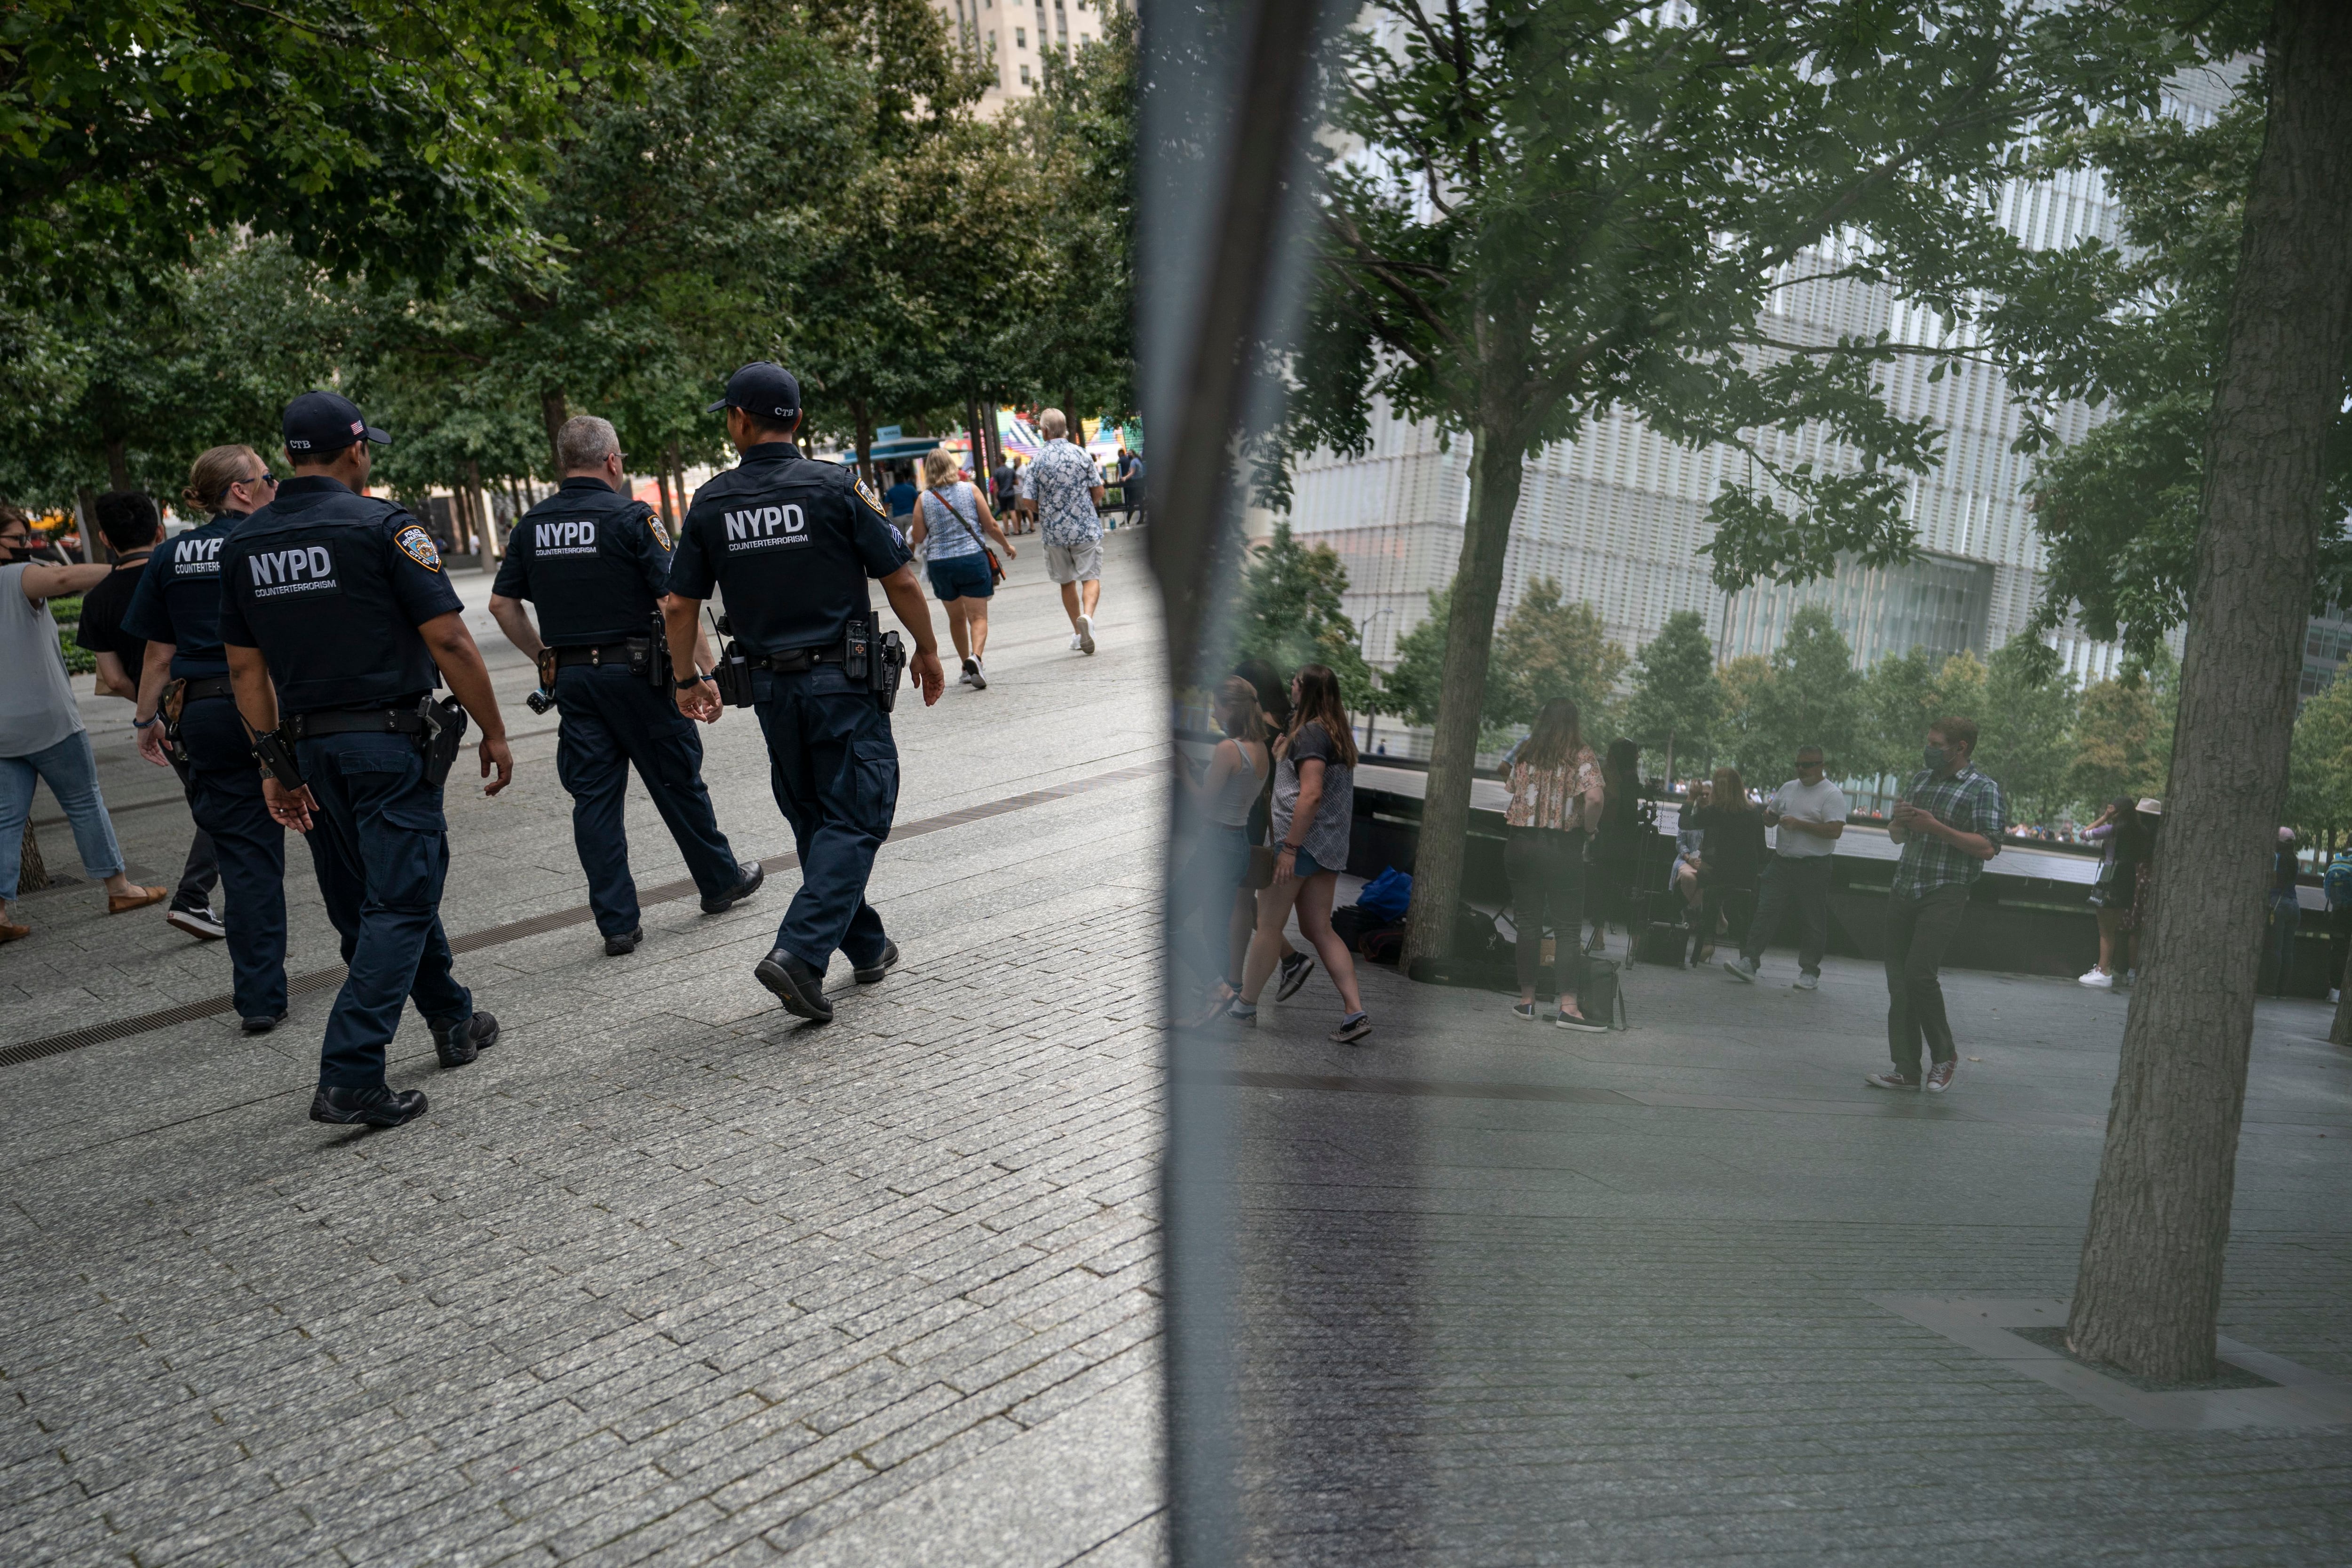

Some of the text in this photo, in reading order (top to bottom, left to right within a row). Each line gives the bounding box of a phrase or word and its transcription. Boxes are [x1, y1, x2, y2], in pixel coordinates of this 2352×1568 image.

[775, 407, 794, 416] CTB
[290, 440, 311, 448] CTB
[724, 504, 804, 541] NYPD
[404, 528, 421, 537] POLICE
[536, 522, 595, 547] NYPD
[729, 534, 808, 551] COUNTERTERRORISM
[175, 538, 224, 563] NYP
[409, 550, 422, 559] CITY
[536, 547, 596, 556] COUNTERTERRORISM
[175, 562, 221, 574] COUNTERTERR
[248, 546, 331, 586] NYPD
[255, 580, 337, 597] COUNTERTERRORISM
